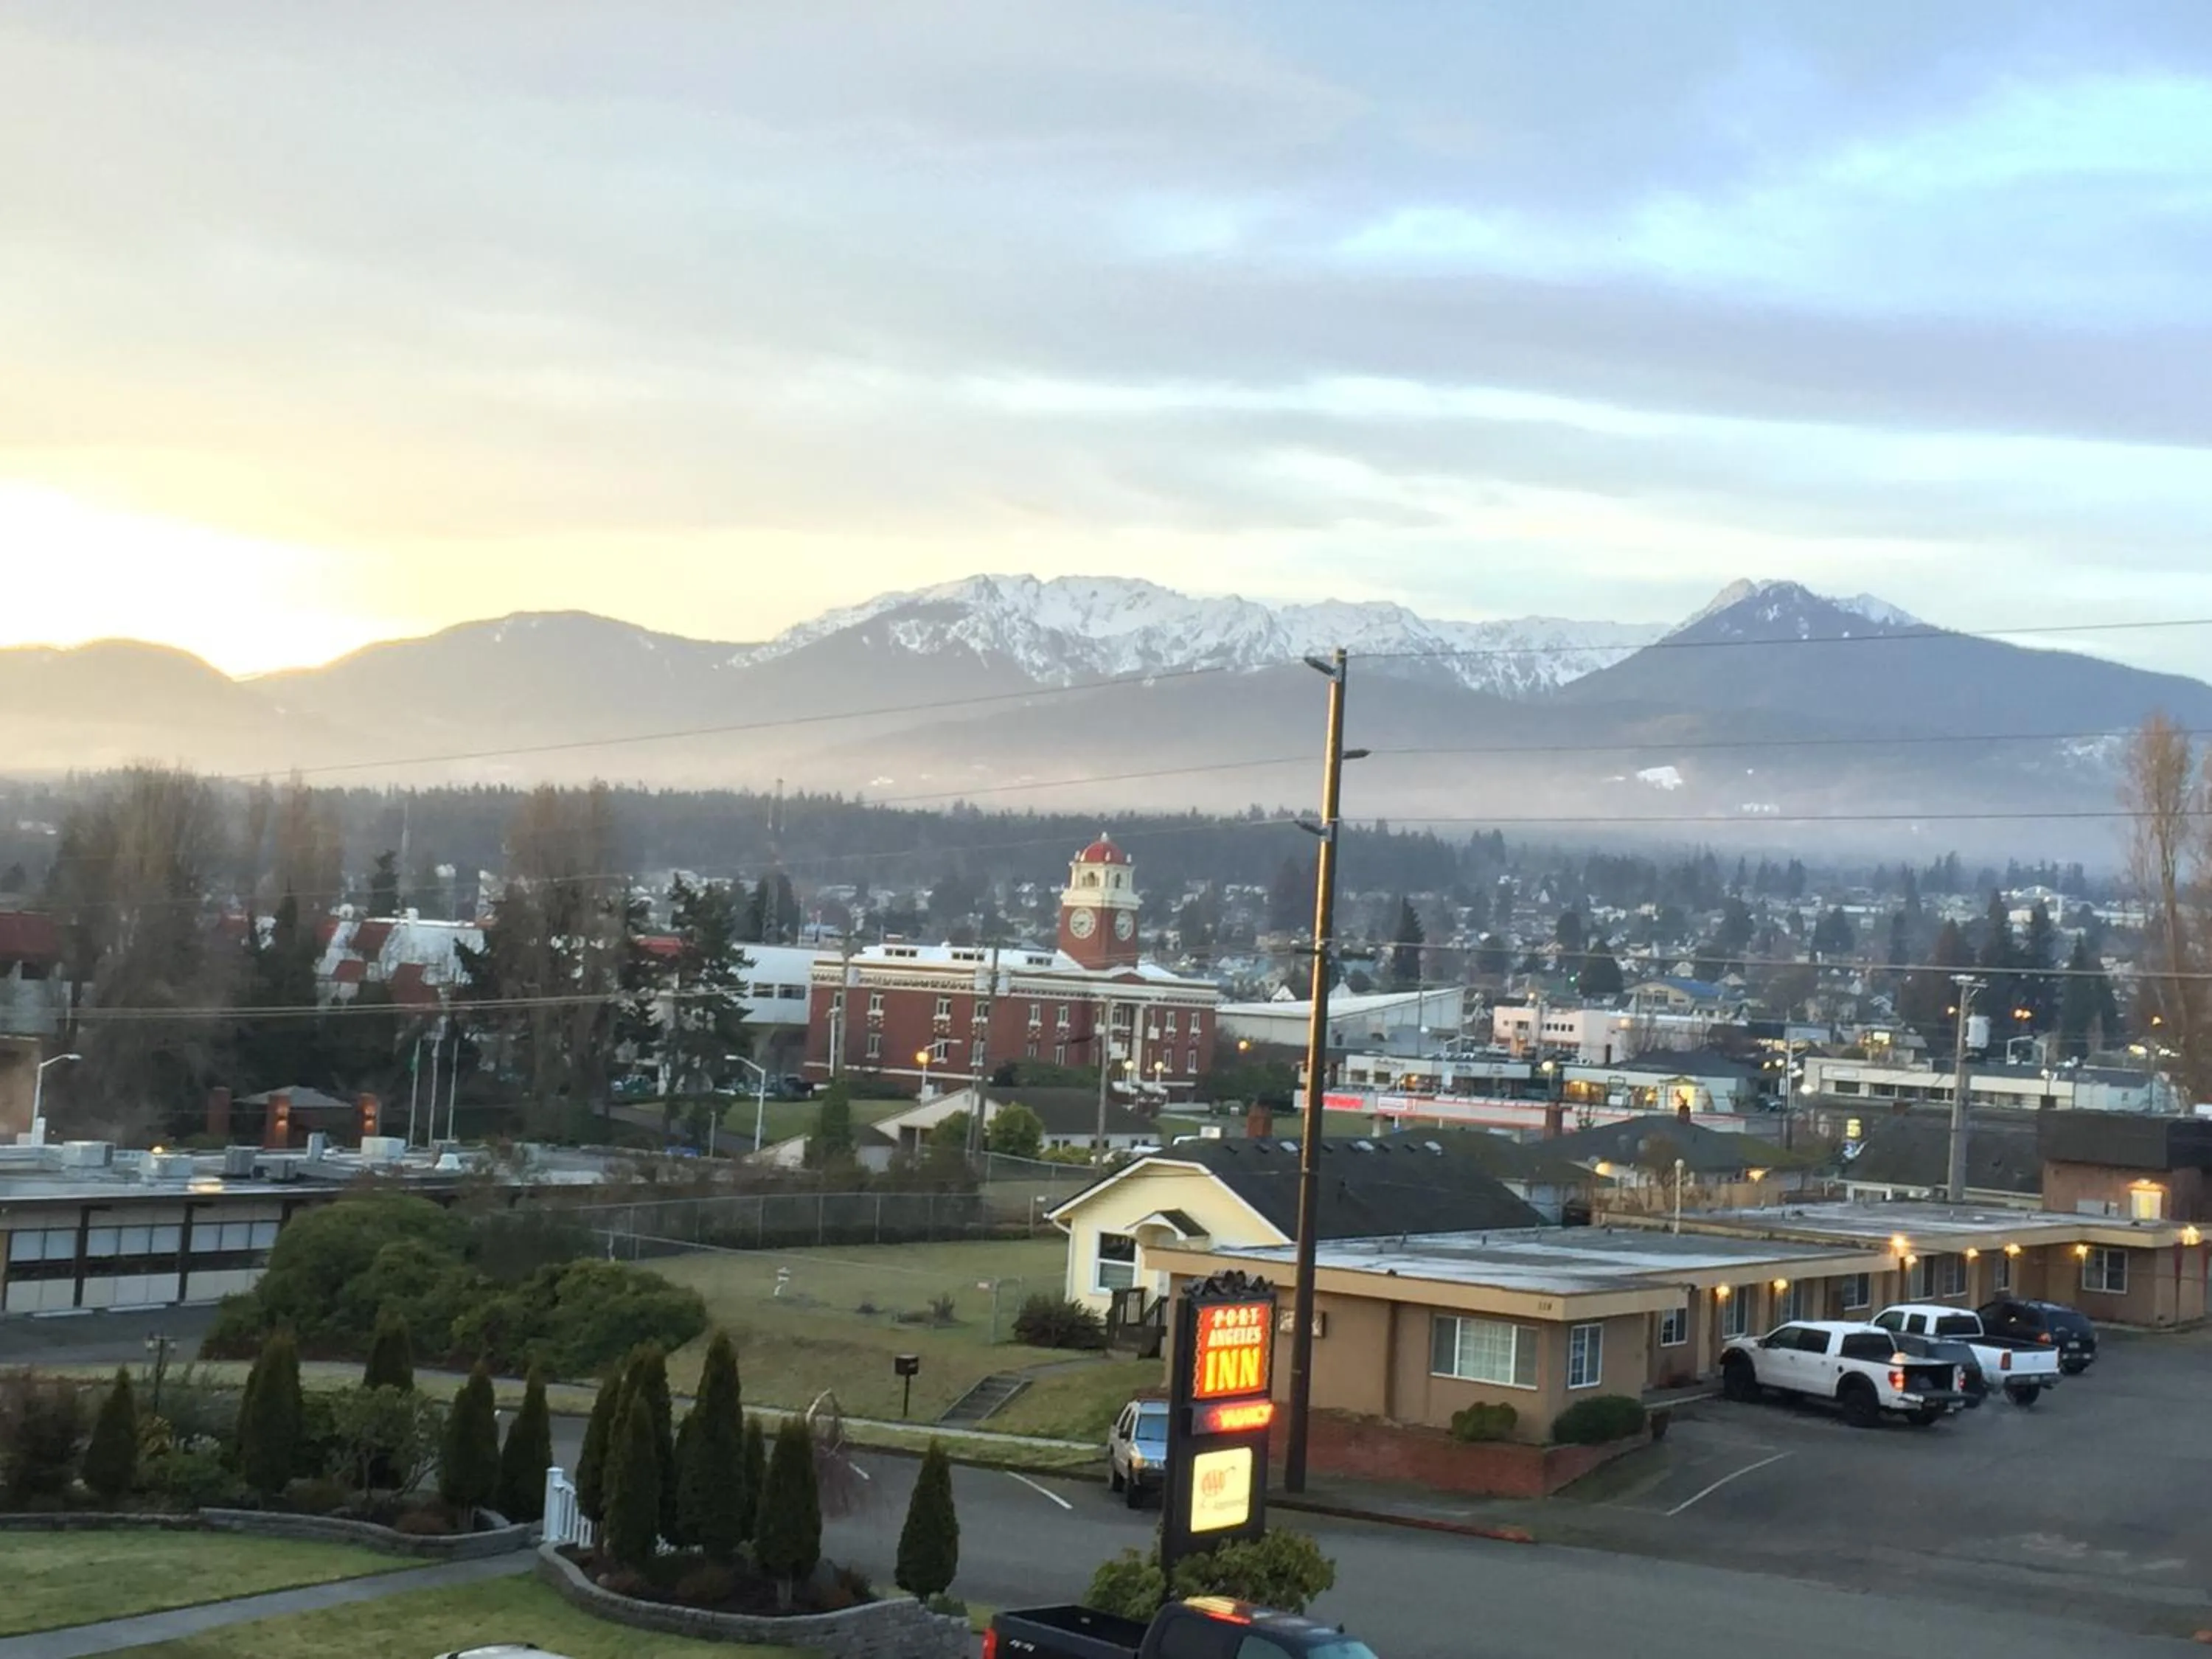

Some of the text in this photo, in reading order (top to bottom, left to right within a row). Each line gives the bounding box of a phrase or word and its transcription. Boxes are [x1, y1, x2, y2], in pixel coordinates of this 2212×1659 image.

[1214, 1307, 1259, 1327] PORT
[1207, 1326, 1262, 1348] ANGELES
[1204, 1347, 1260, 1392] INN
